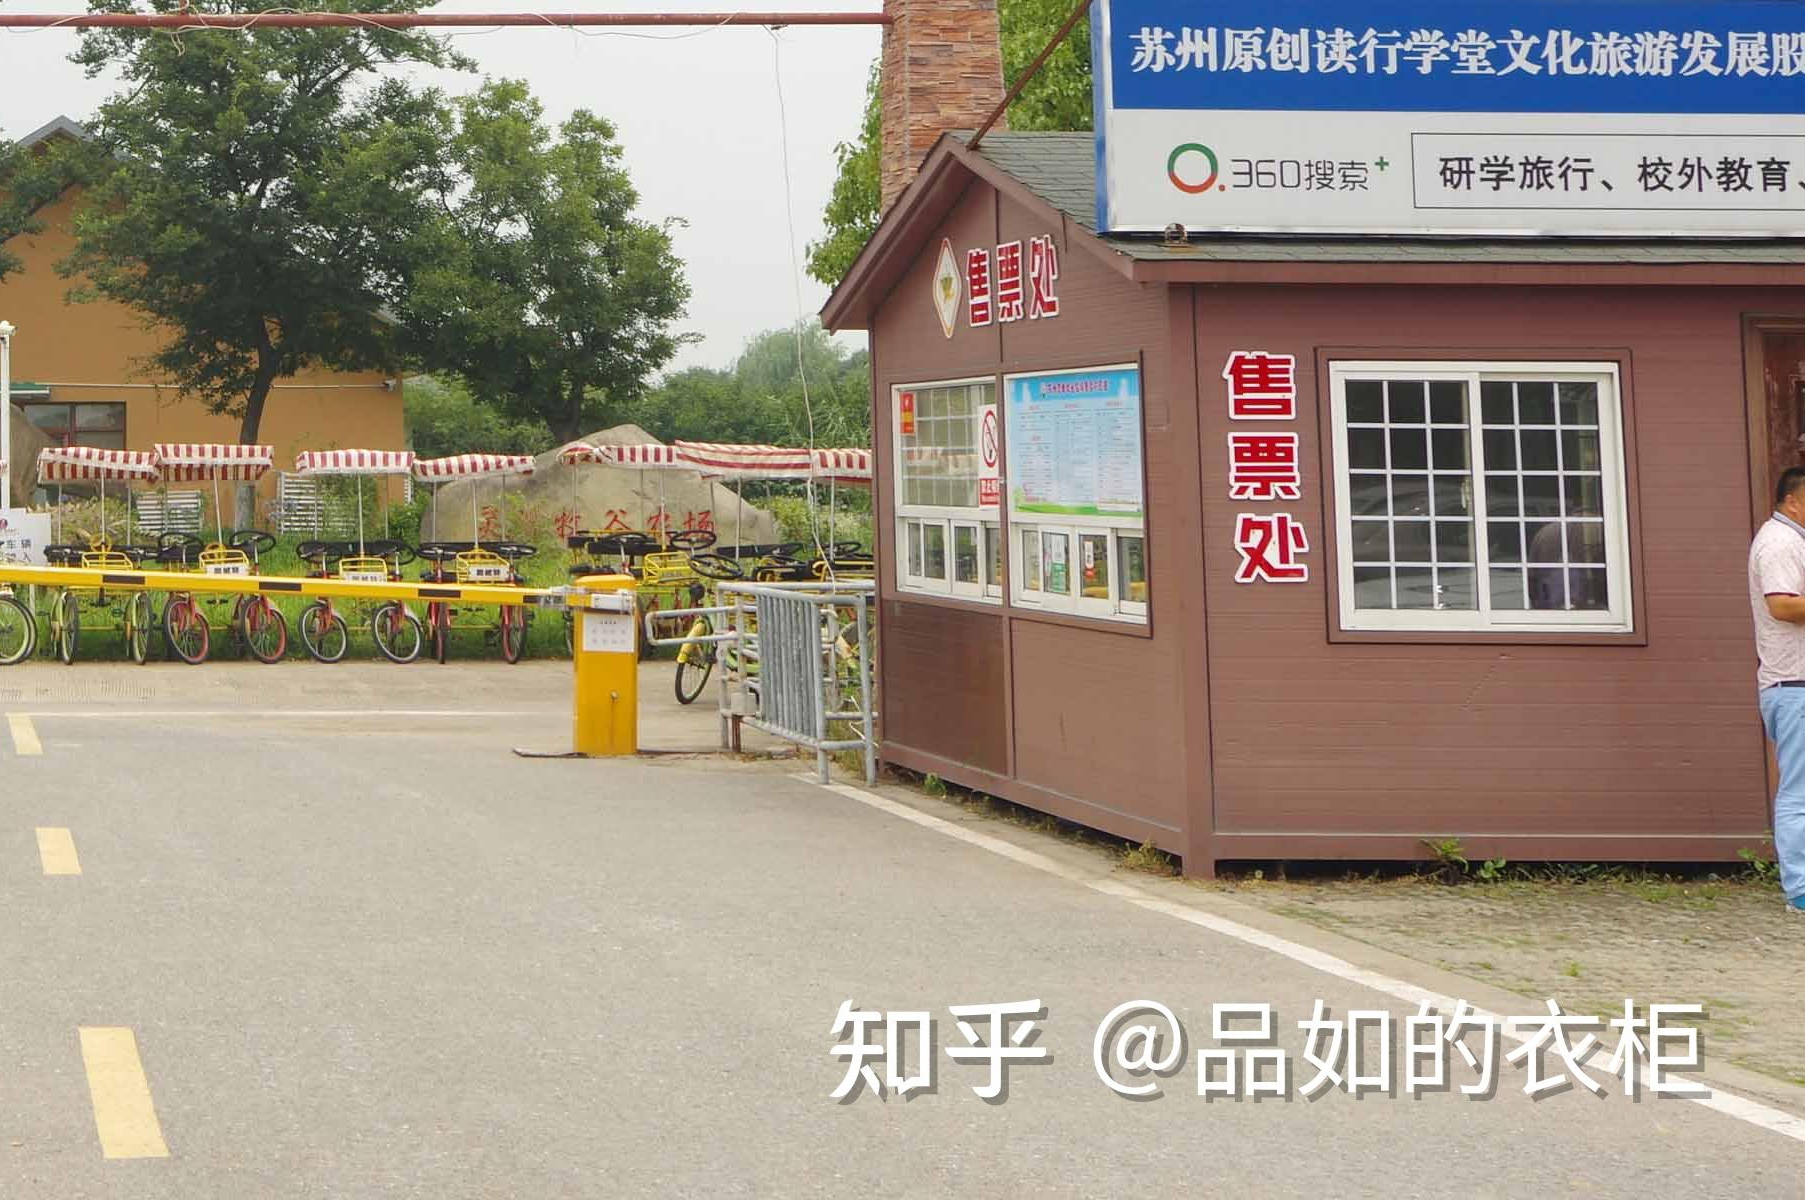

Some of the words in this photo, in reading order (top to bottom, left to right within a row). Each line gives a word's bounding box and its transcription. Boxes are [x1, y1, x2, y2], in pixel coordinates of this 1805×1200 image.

[1129, 26, 1805, 78] 苏州原创读行学堂文化旅游发展股
[966, 233, 1060, 327] 售票处
[1222, 351, 1310, 583] 售票处
